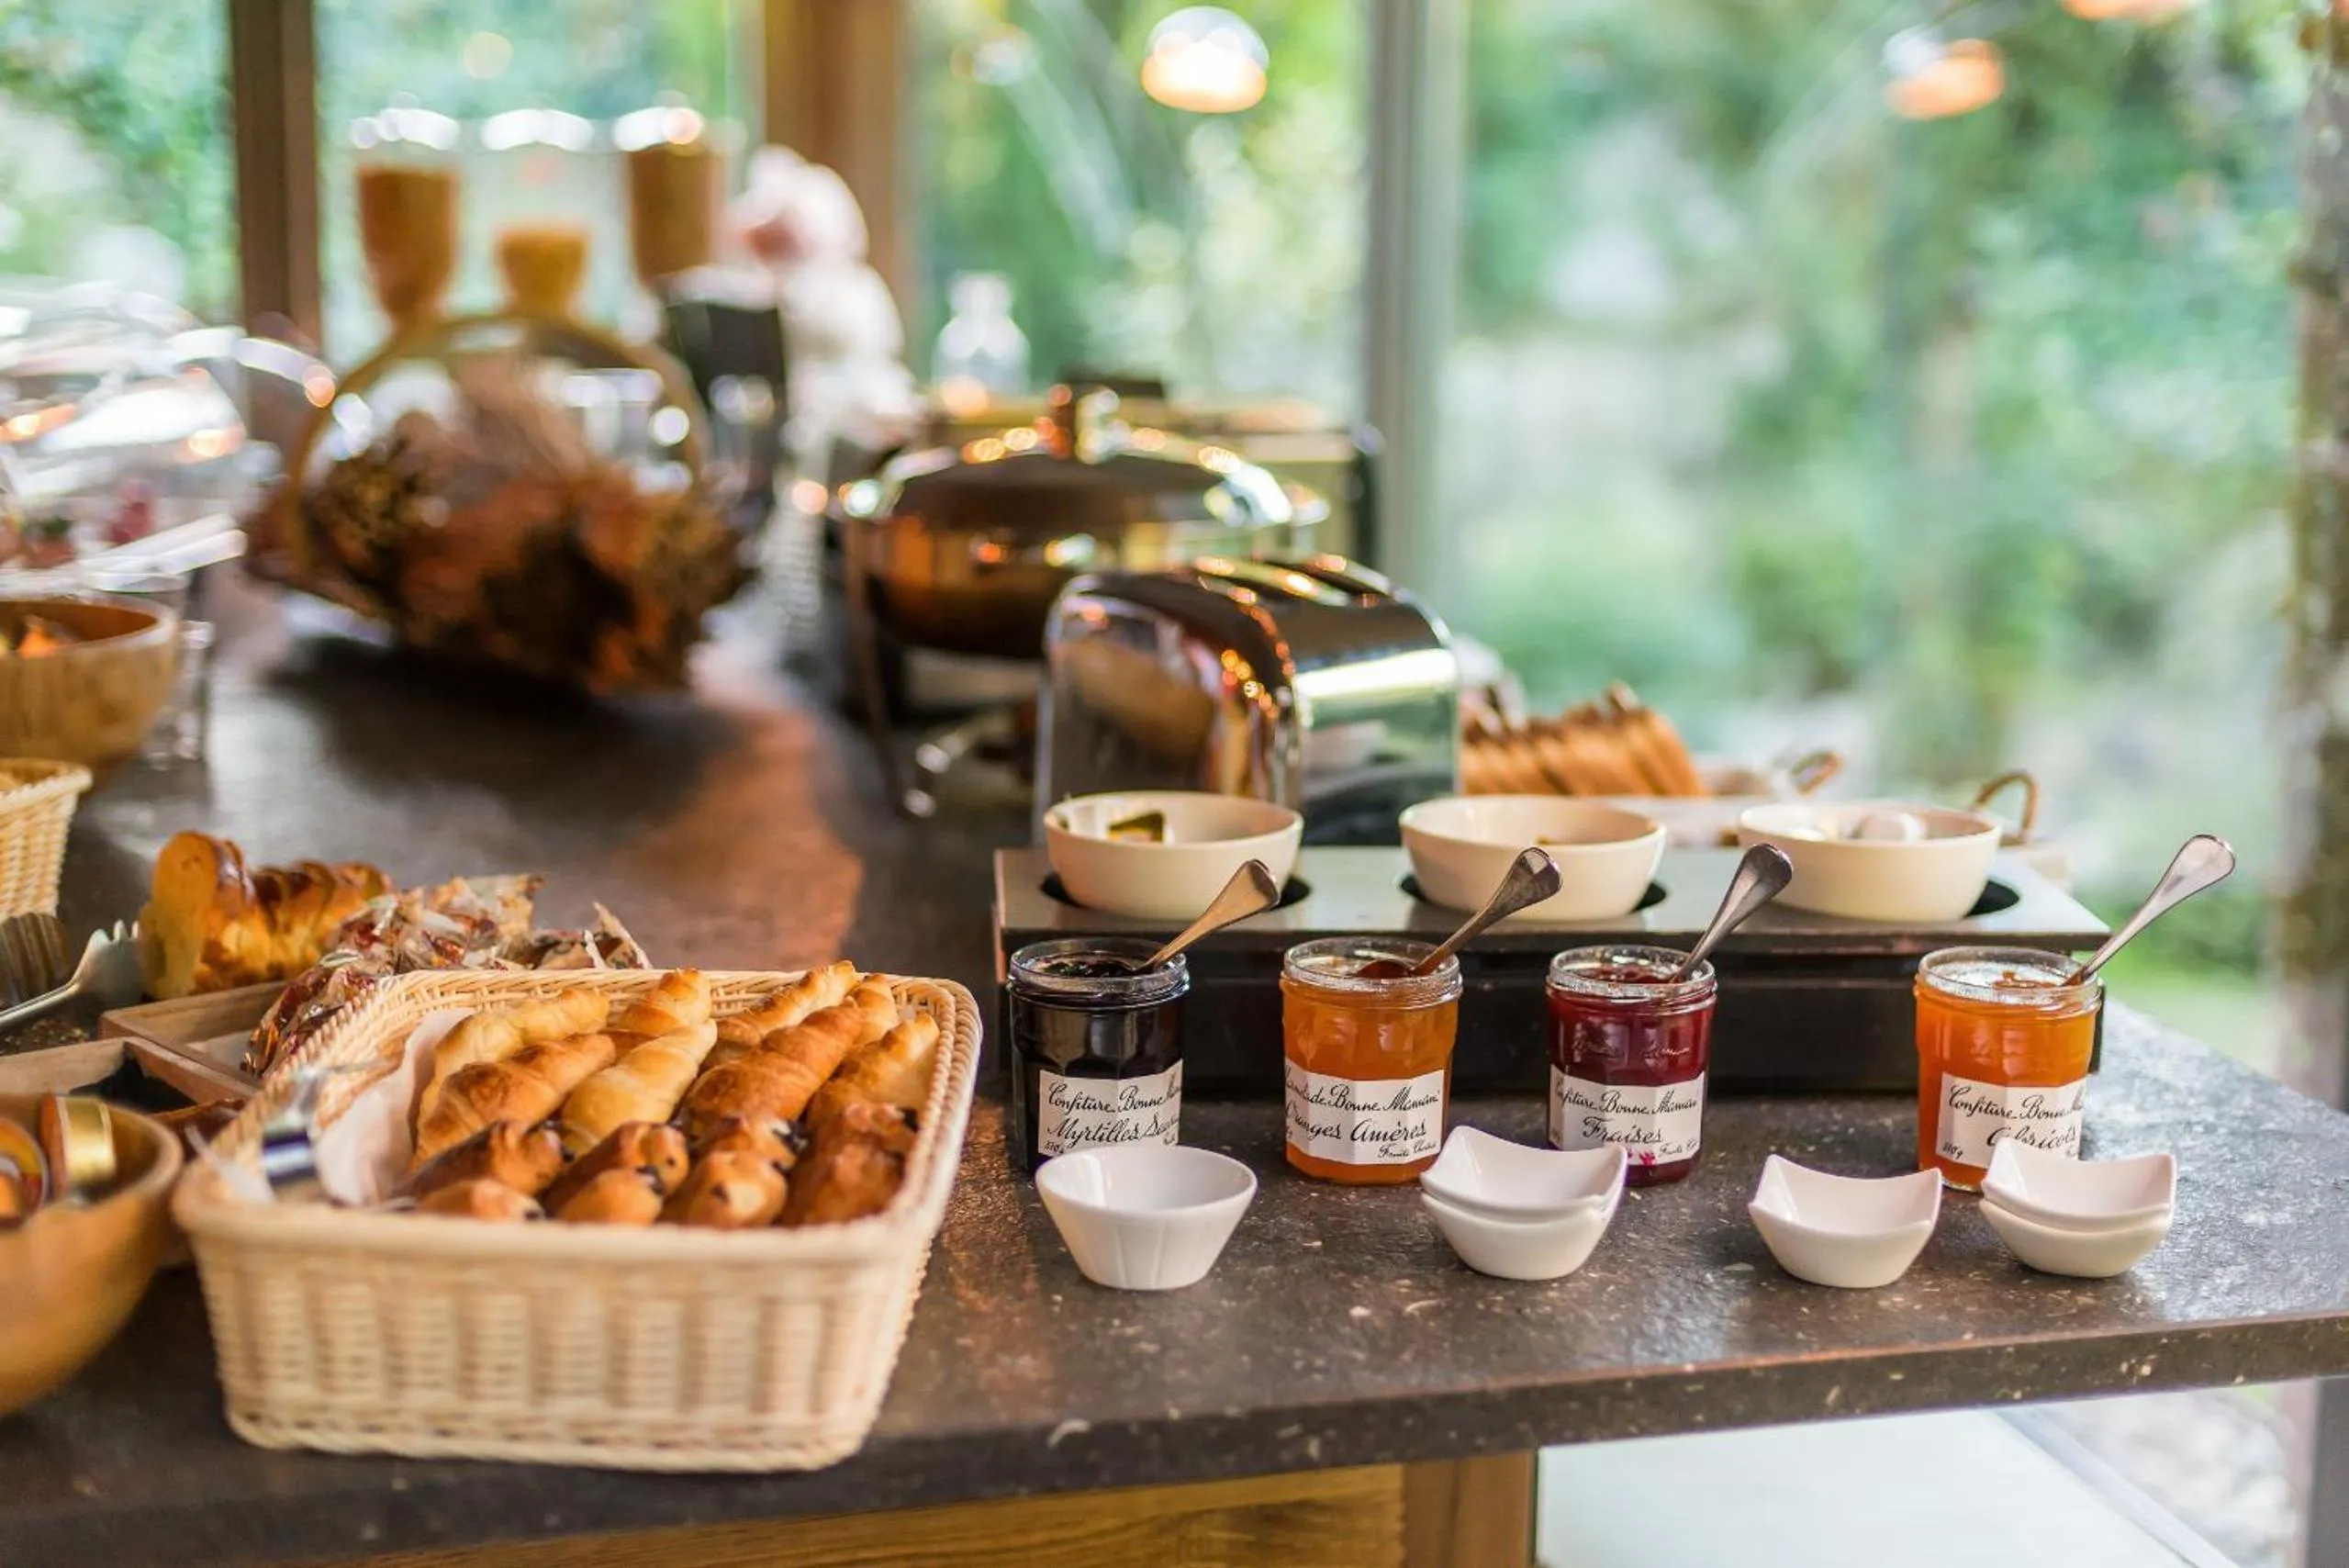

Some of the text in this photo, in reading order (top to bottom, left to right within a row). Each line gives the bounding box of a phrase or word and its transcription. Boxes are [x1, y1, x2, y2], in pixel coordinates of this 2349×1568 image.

[1048, 1081, 1165, 1115] Confiture Bonne
[1328, 1084, 1380, 1112] Bonne
[1598, 1090, 1650, 1114] Bonne
[1949, 1085, 2018, 1117] Confiture
[1046, 1117, 1140, 1148] Myrtilles
[1350, 1118, 1427, 1143] Amères
[1583, 1116, 1663, 1144] Fraises
